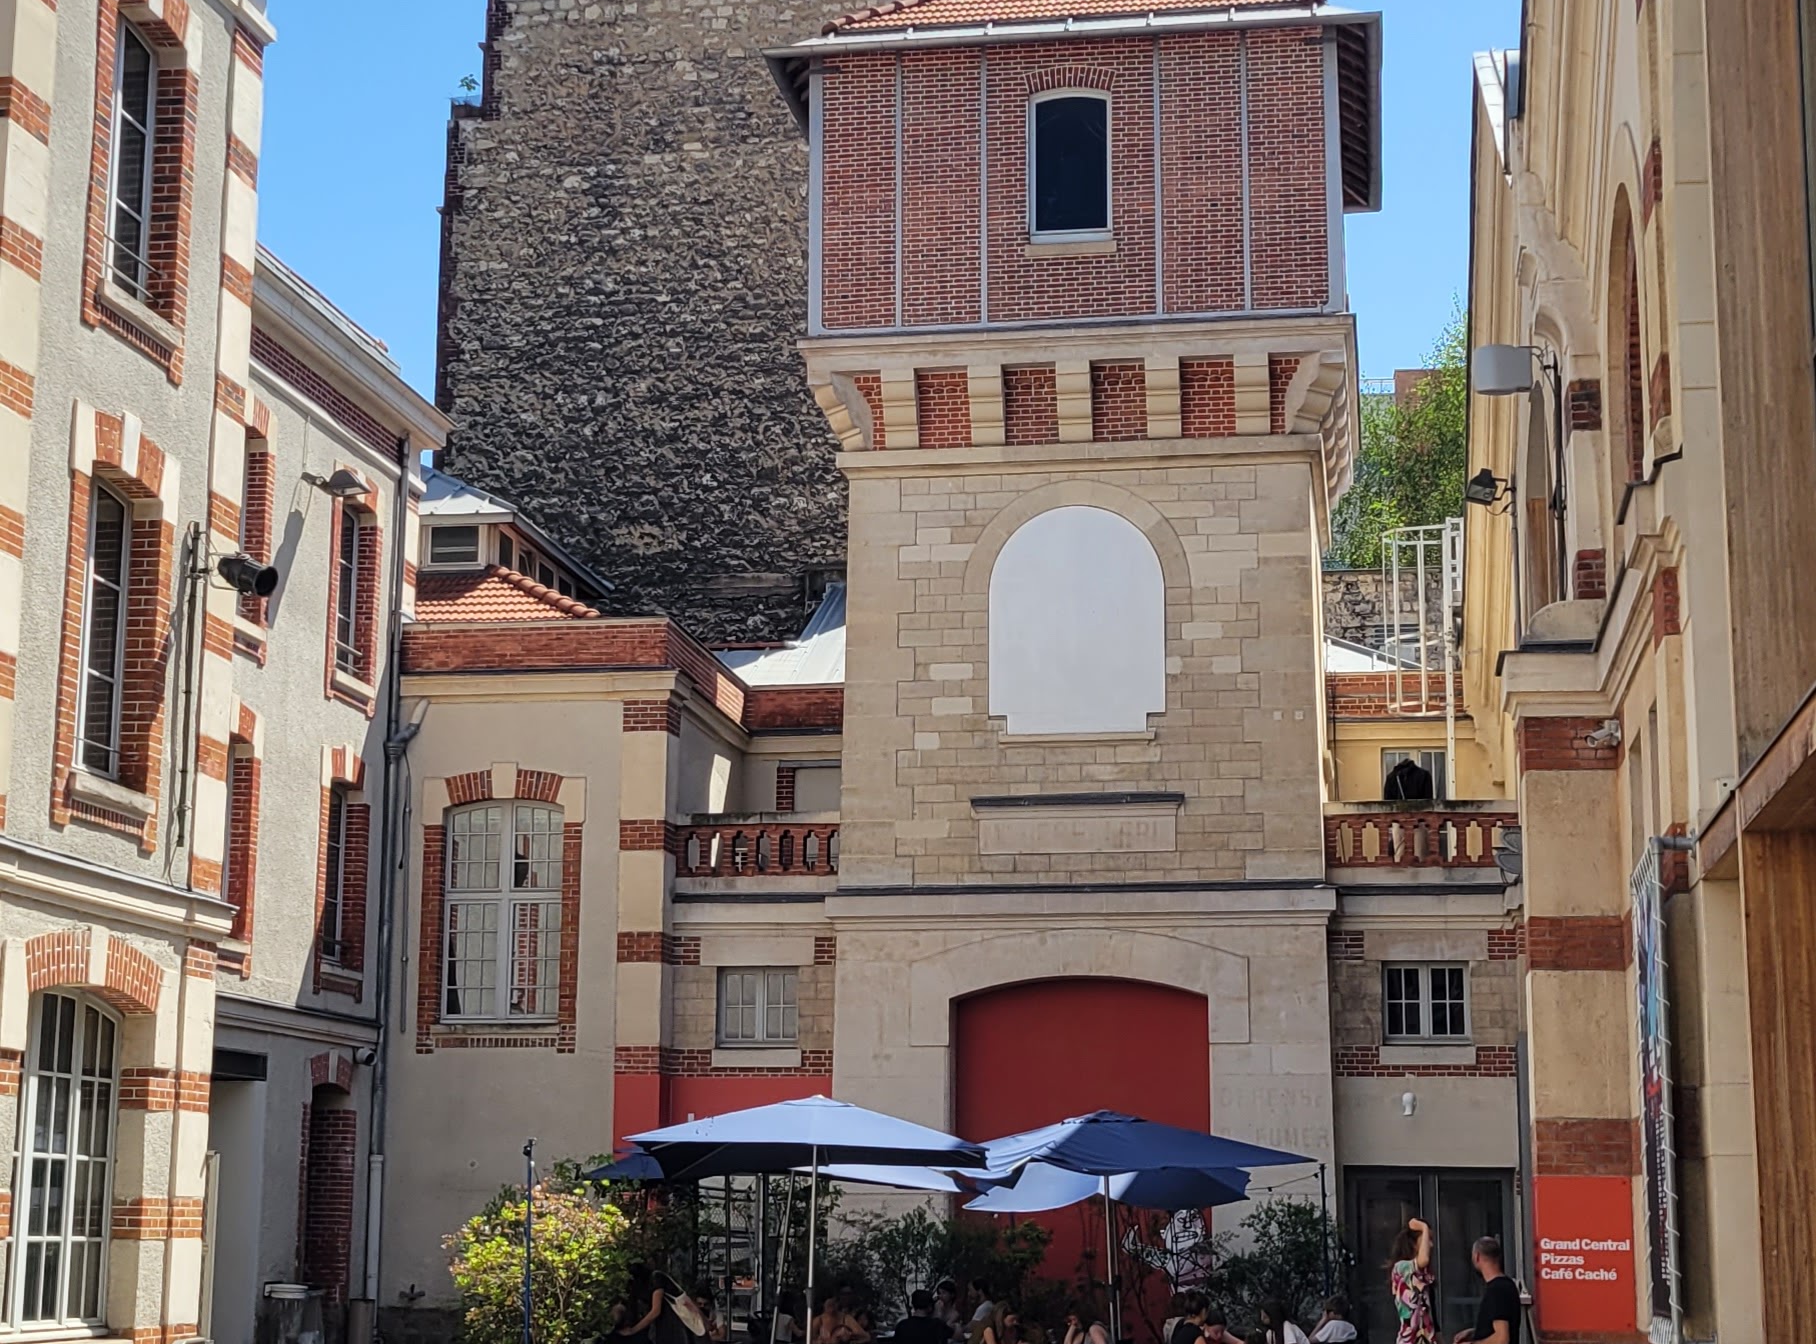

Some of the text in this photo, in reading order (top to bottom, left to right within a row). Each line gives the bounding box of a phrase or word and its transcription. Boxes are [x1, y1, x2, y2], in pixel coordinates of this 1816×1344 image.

[1540, 1238, 1630, 1251] Grand Central
[1541, 1253, 1584, 1265] Pizzas
[1541, 1268, 1617, 1280] Café Caché
